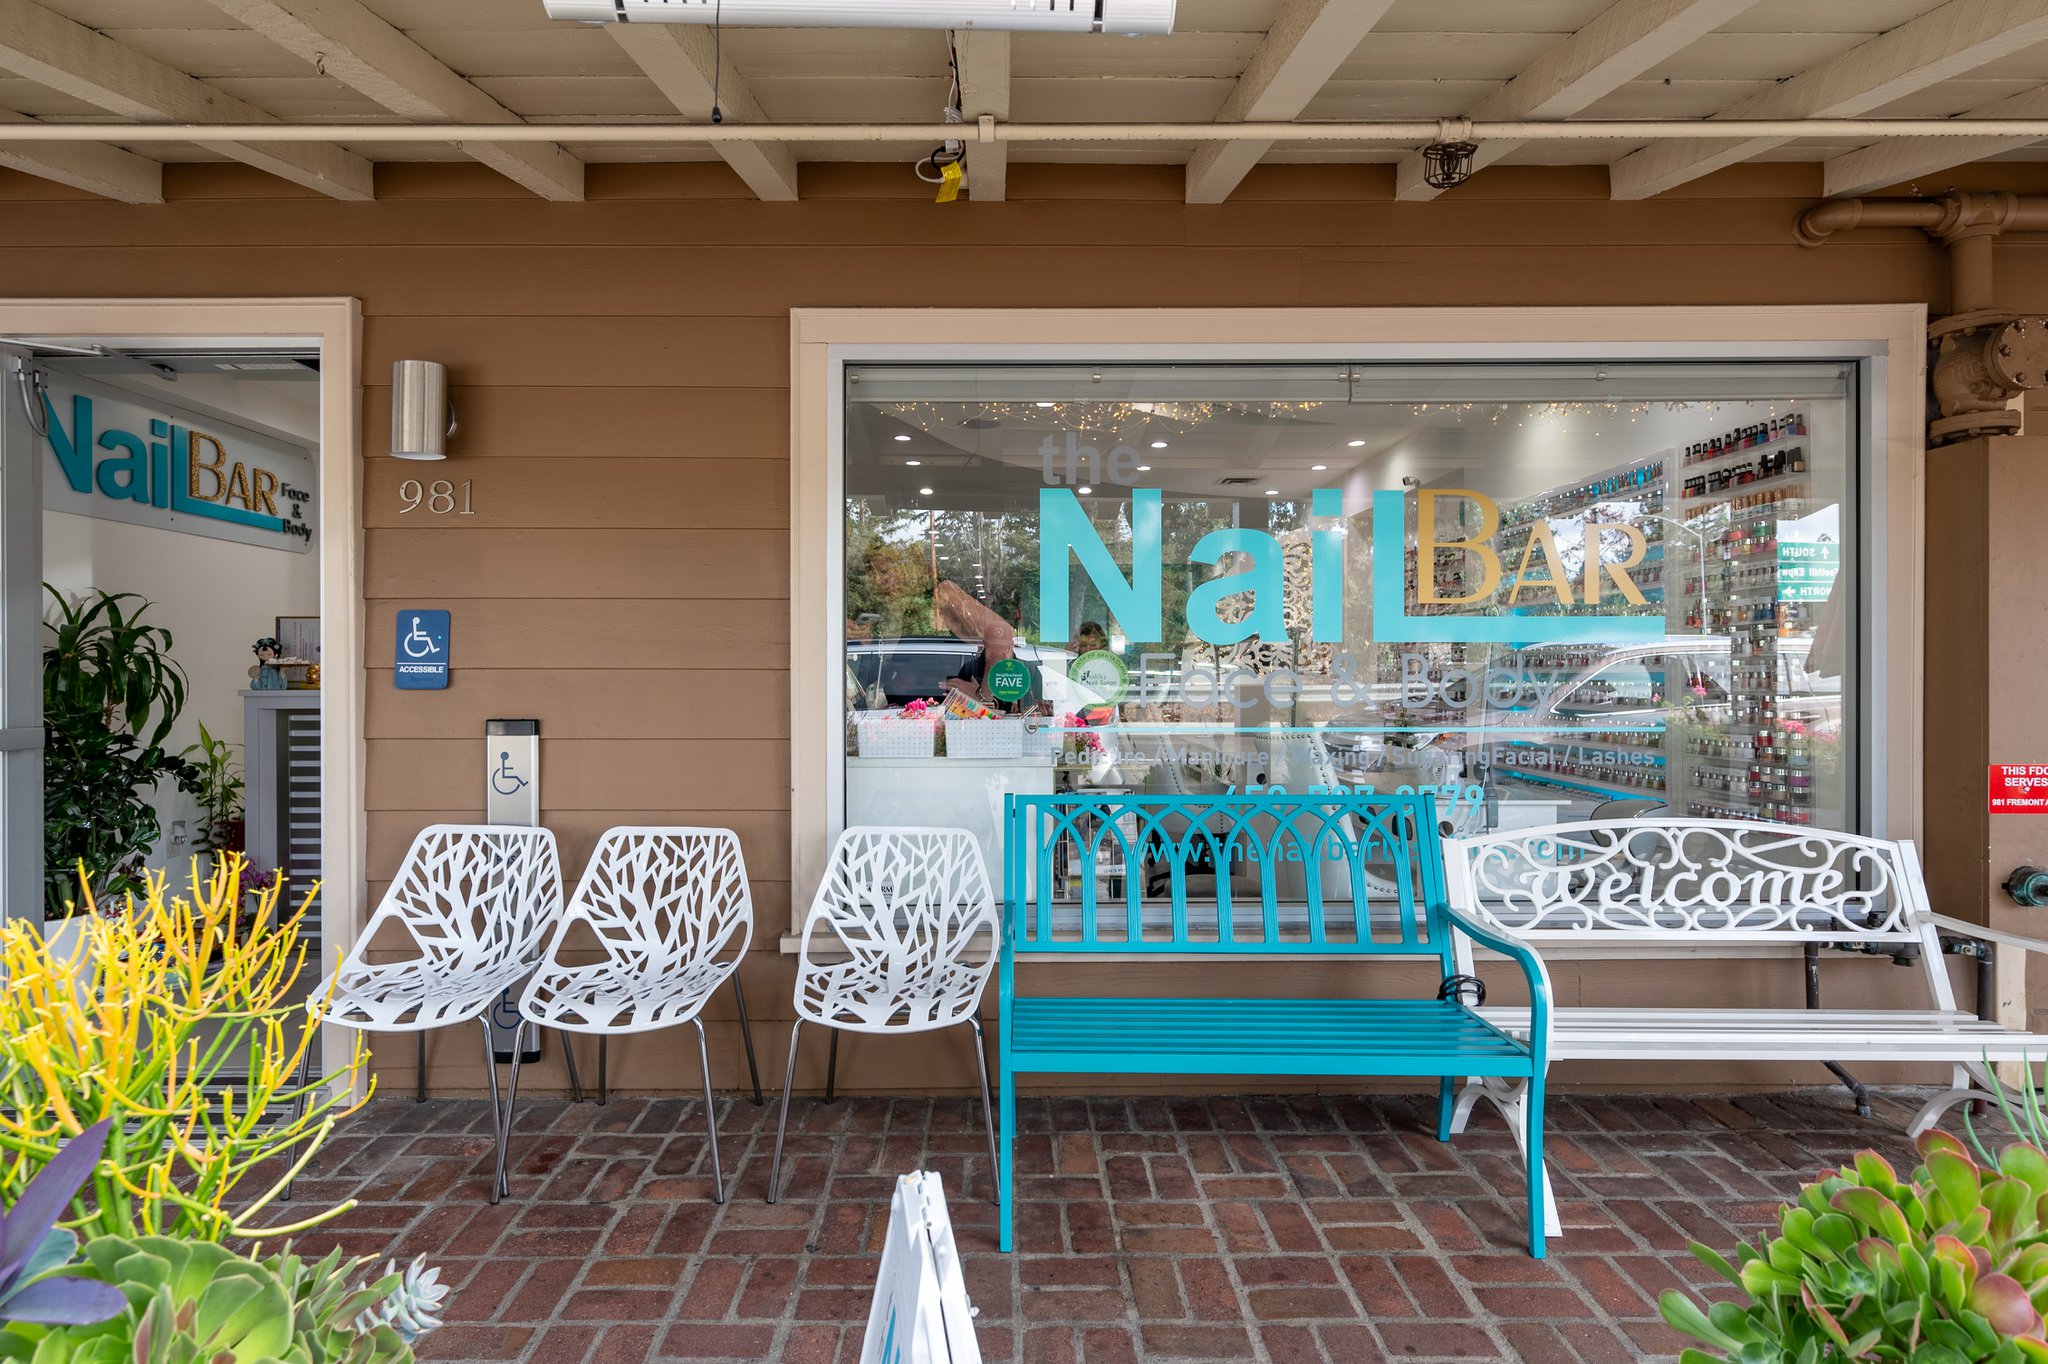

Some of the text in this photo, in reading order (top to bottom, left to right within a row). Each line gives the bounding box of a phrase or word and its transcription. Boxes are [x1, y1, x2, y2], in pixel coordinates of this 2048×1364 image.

[1038, 432, 1143, 485] the
[189, 430, 279, 516] BAR
[281, 482, 310, 502] Face
[400, 480, 475, 514] 981
[292, 503, 302, 519] &
[283, 518, 312, 542] Body
[1418, 488, 1649, 605] BAR
[399, 665, 444, 674] ACCESSIBLE
[995, 677, 1023, 687] FAVE
[1140, 653, 1559, 720] Face & Body
[1167, 746, 1269, 766] Manicure
[1579, 746, 1655, 766] Lashes
[2001, 766, 2026, 775] THIS
[2004, 777, 2048, 787] SERVES
[1992, 798, 2005, 806] 981
[2006, 798, 2045, 806] FREMONT
